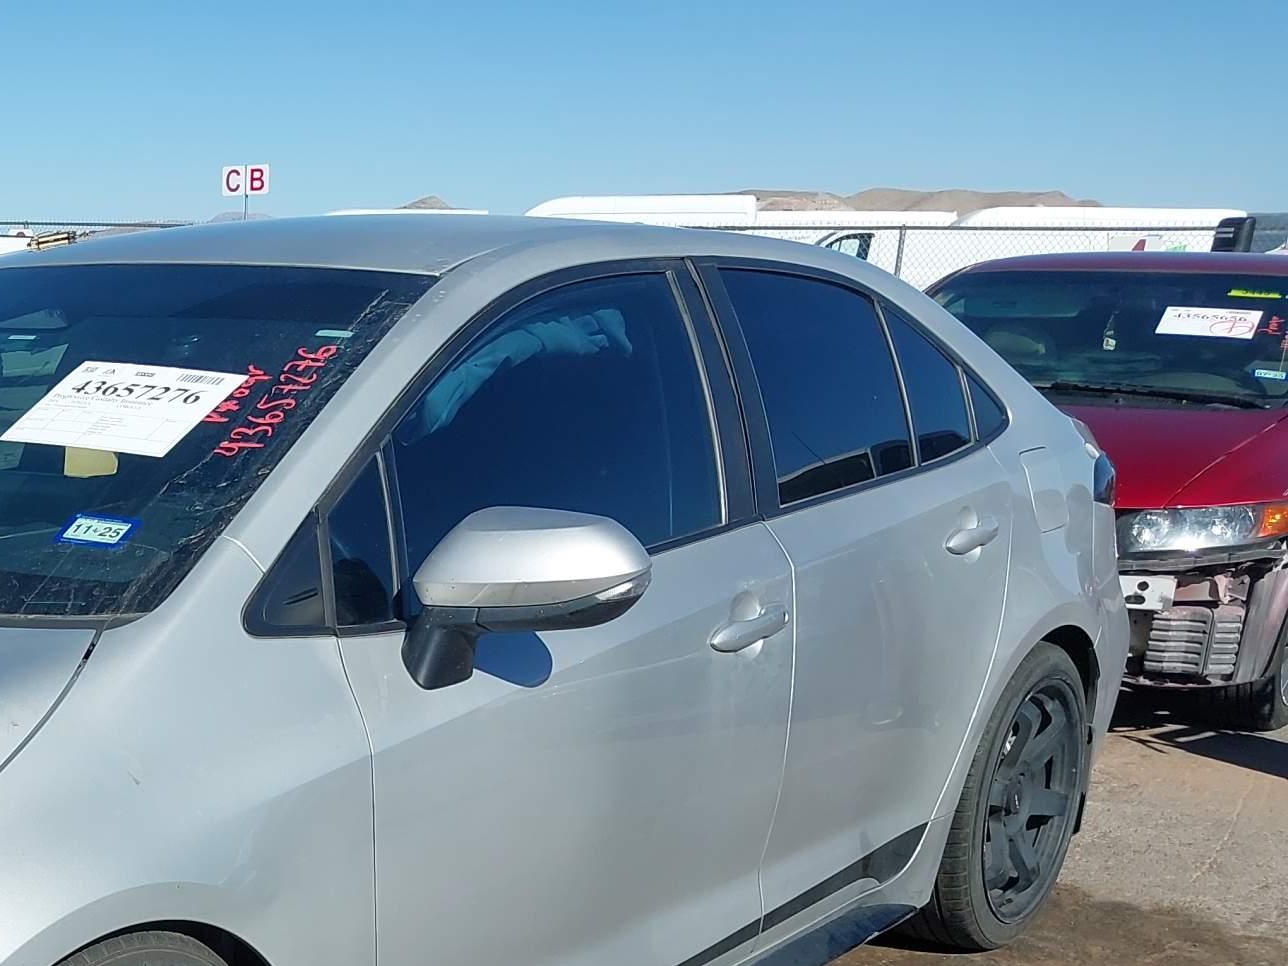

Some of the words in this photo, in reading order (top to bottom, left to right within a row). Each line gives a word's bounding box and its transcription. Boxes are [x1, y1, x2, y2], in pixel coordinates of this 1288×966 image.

[225, 169, 241, 192] C
[249, 168, 265, 191] B
[72, 379, 207, 405] 43657276
[212, 345, 338, 457] 43657276
